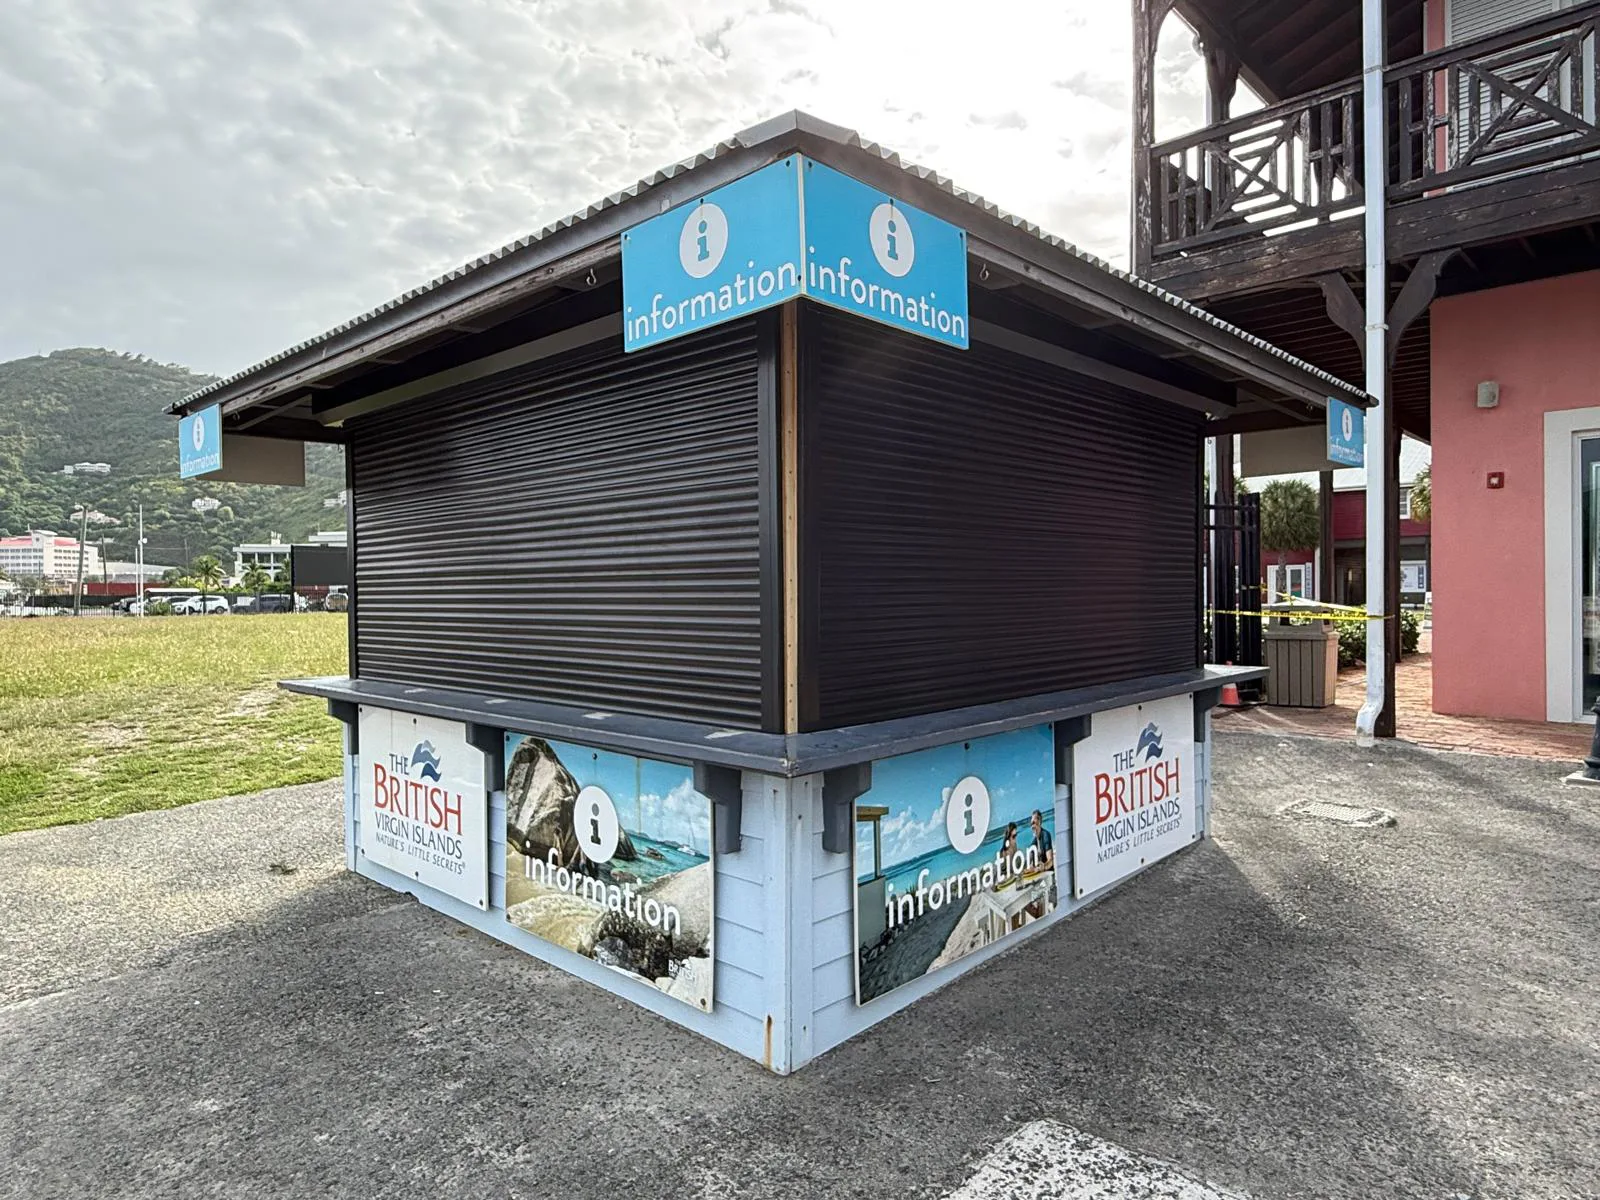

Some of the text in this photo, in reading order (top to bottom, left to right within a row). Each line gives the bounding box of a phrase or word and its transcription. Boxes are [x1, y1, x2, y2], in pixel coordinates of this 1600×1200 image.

[627, 260, 797, 343] information
[809, 246, 965, 339] information
[389, 753, 410, 775] THE
[1113, 748, 1135, 773] THE
[374, 763, 462, 836] BRITISH
[1094, 757, 1180, 825] BRITISH
[375, 811, 463, 860] VIRGIN ISLANDS
[376, 832, 405, 853] NATURE'S
[408, 844, 430, 862] LITTLE
[1096, 797, 1180, 848] VIRGIN ISLANDS
[1097, 839, 1131, 863] NATURE'S
[1133, 828, 1155, 848] LITTLE
[524, 841, 681, 935] information
[885, 840, 1039, 929] information
